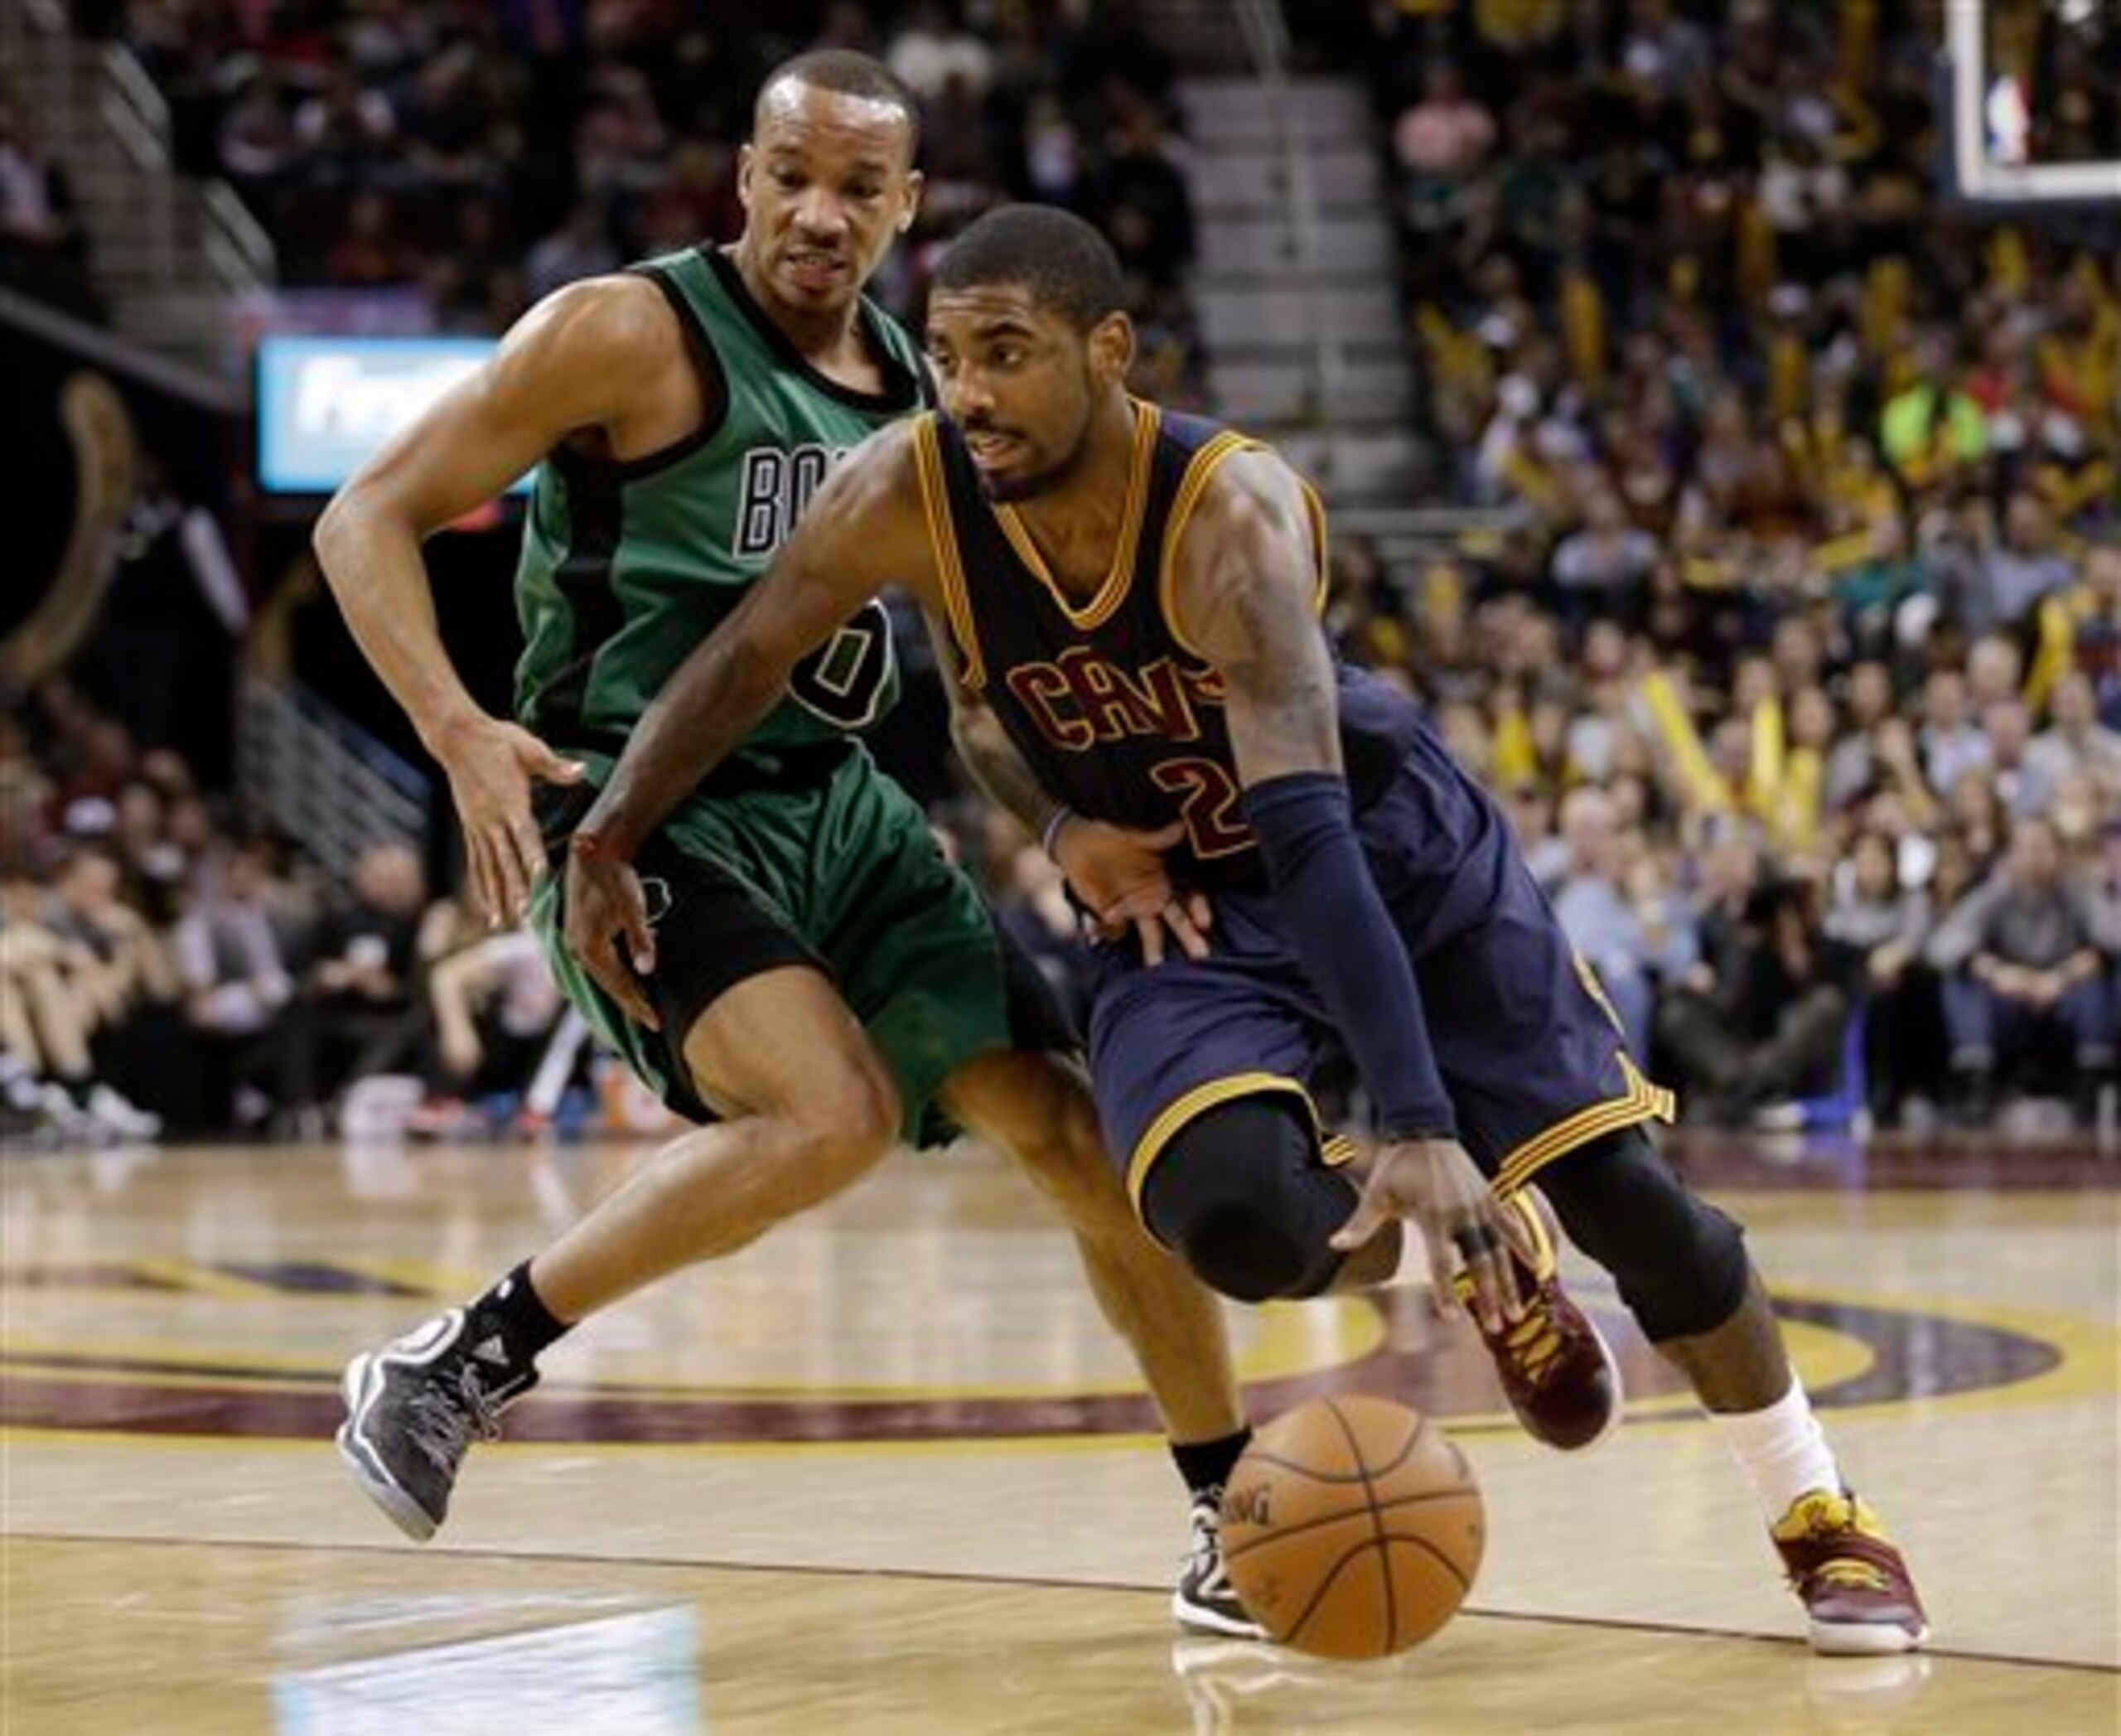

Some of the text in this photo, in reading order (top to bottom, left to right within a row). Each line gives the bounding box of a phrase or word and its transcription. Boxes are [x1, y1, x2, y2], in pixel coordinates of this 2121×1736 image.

[733, 444, 846, 559] BO
[786, 597, 893, 729] 0
[1149, 757, 1257, 859] 2
